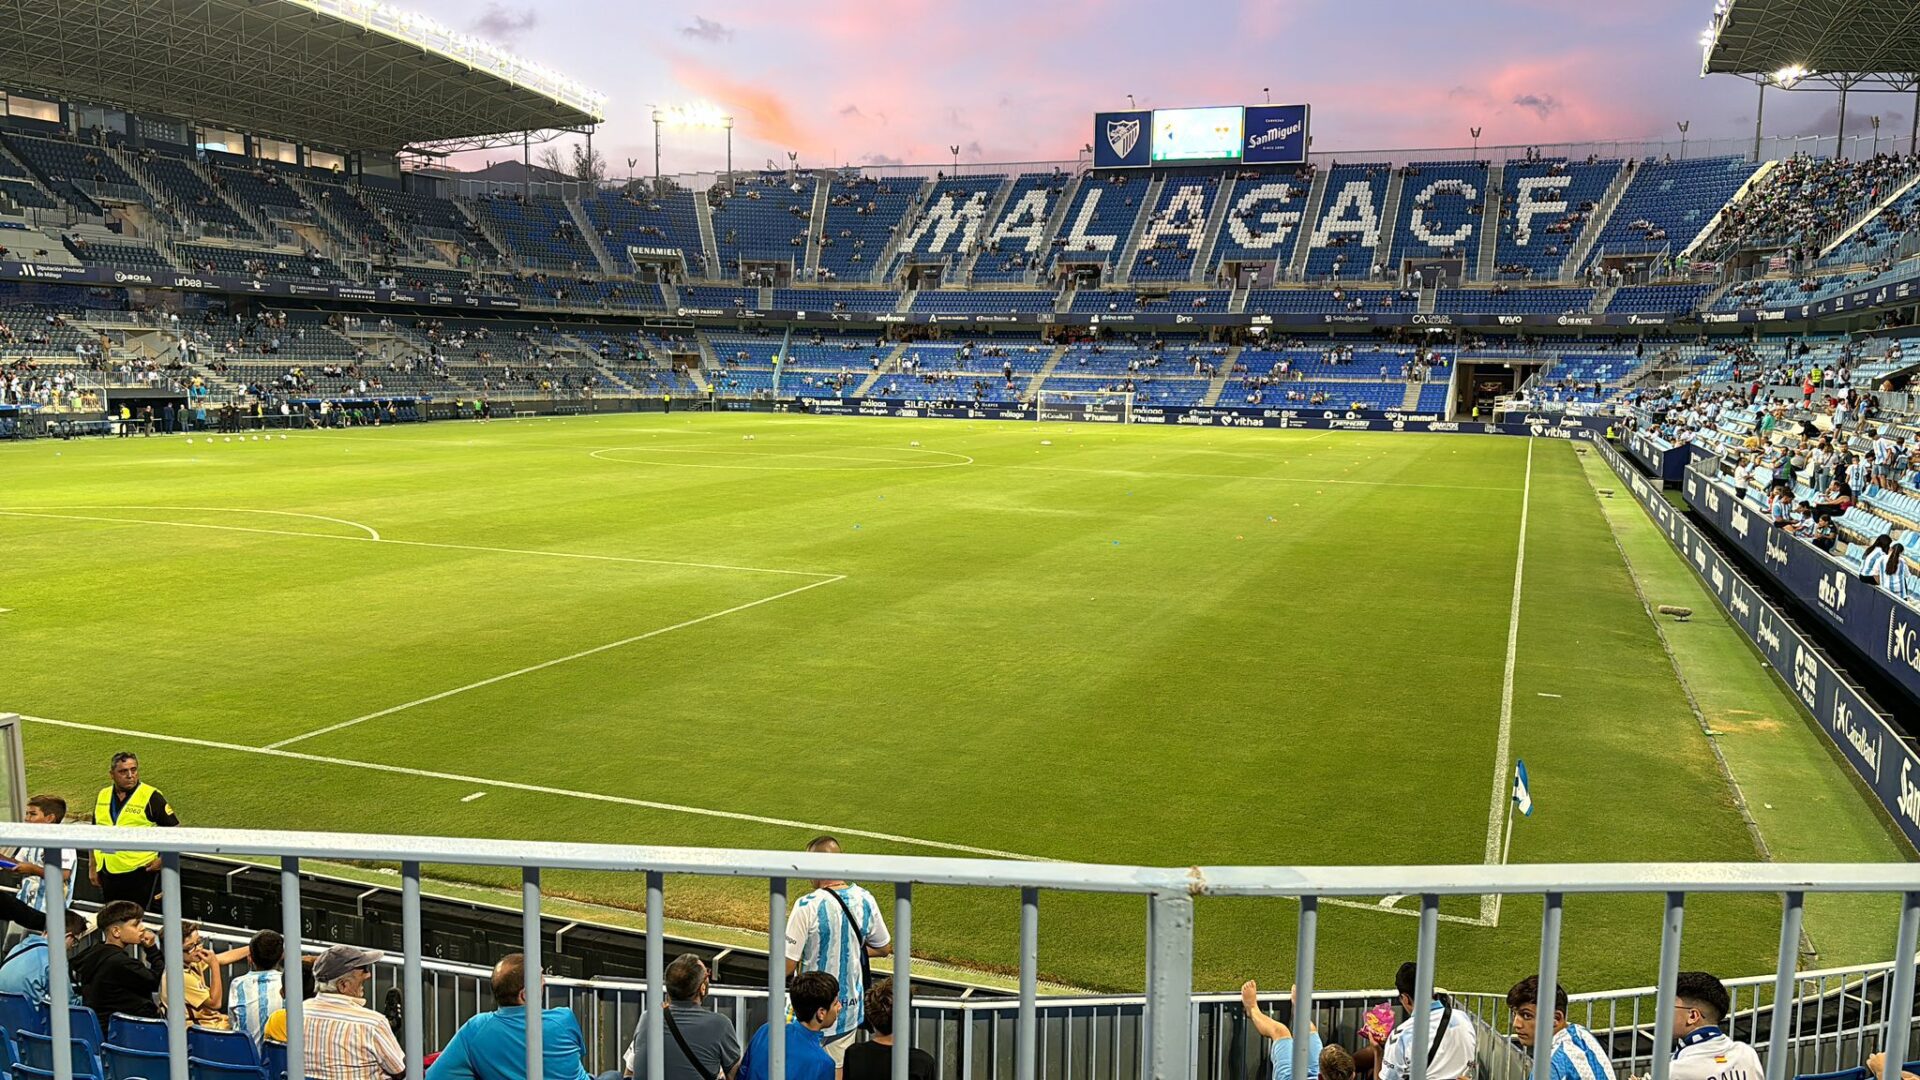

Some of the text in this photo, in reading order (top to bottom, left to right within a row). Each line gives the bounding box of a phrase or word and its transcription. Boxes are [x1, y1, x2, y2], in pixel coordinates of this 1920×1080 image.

[632, 246, 677, 256] BENAMIEL
[1710, 312, 1738, 323] hummel
[1763, 308, 1786, 320] hummel
[1138, 414, 1166, 423] hummel
[1233, 416, 1264, 427] vithas
[1544, 427, 1571, 439] vithas
